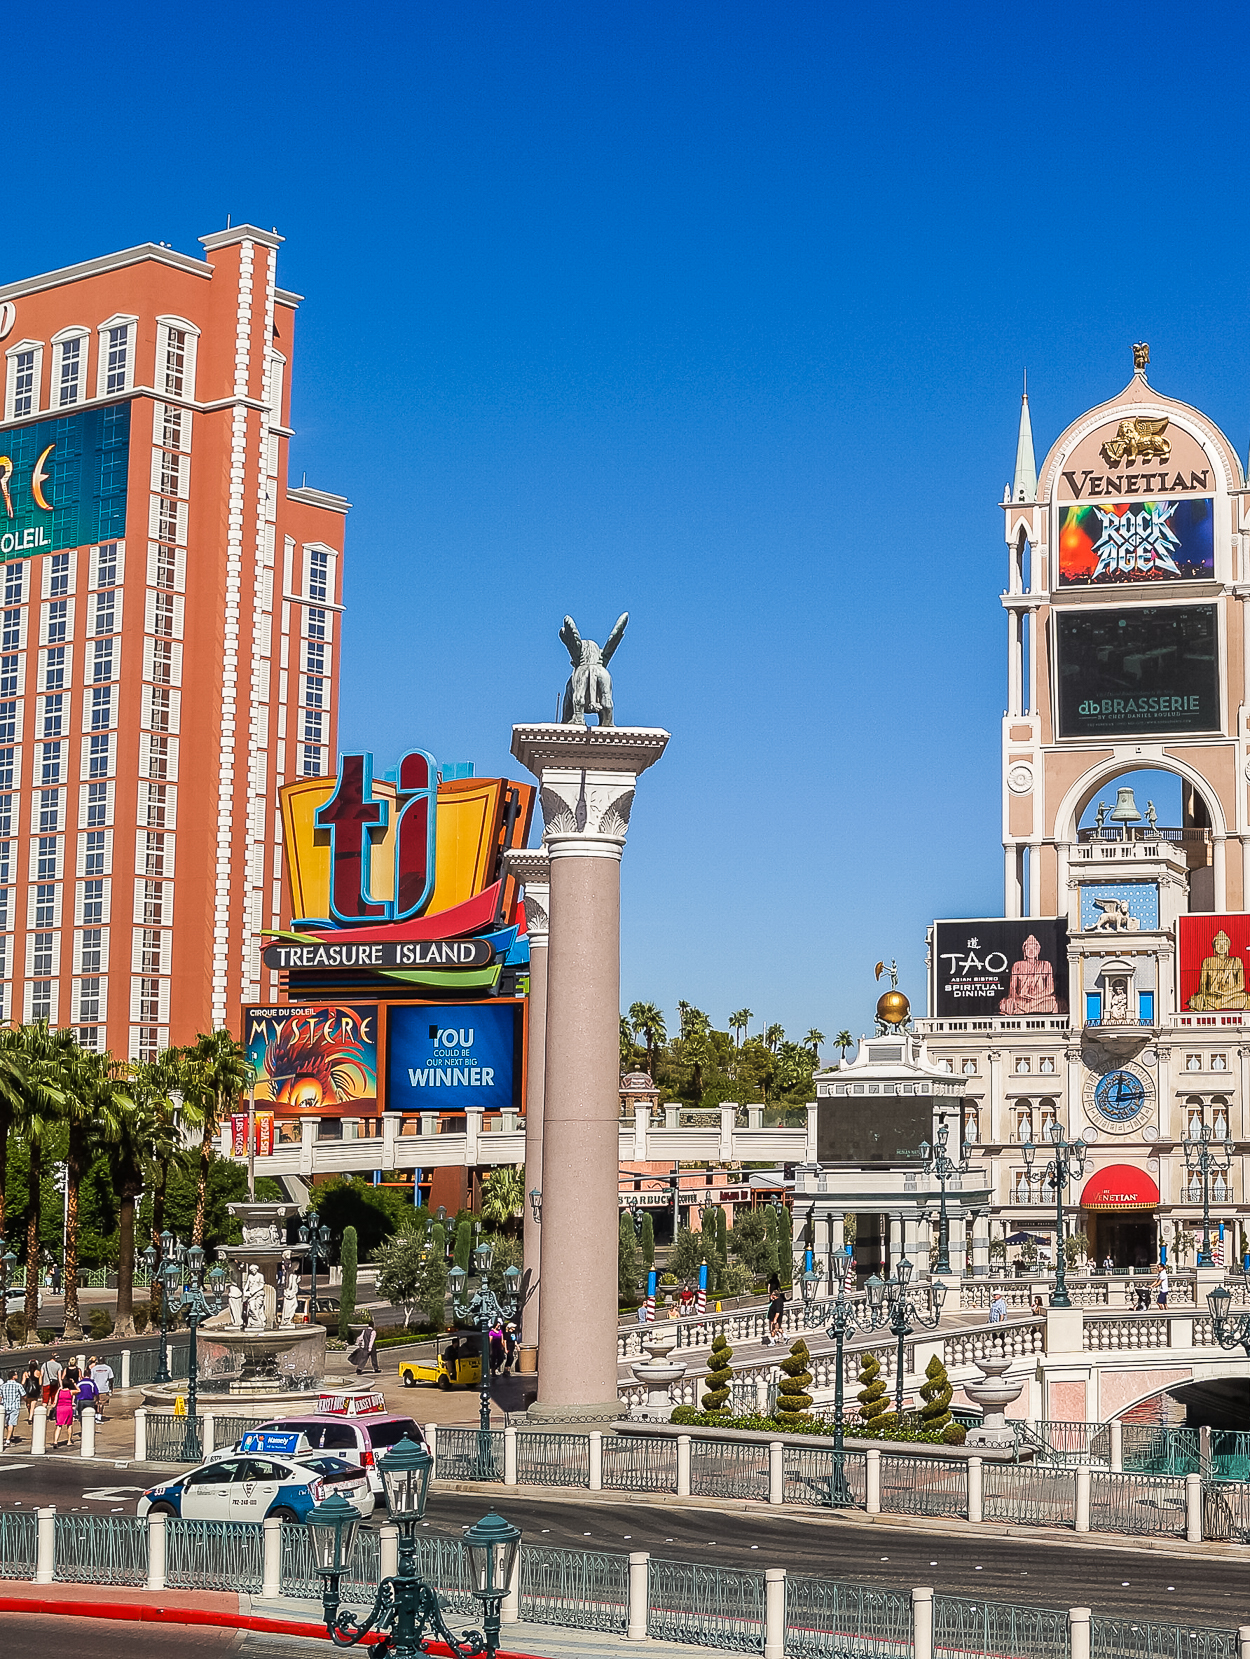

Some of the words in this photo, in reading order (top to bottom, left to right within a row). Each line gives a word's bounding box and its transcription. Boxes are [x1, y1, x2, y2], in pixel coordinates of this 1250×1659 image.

[1062, 469, 1209, 500] VENETIAN
[1091, 502, 1182, 550] ROCK
[1128, 534, 1142, 546] OF
[1091, 538, 1182, 579] AGES
[276, 944, 383, 967] TREASURE
[395, 942, 476, 965] ISLAND
[250, 1009, 278, 1018] CIRQUE
[291, 1008, 317, 1016] SOLEIL
[249, 1012, 373, 1048] MYSTÈRE
[426, 1058, 443, 1066] OUR
[444, 1058, 463, 1066] NEXT
[464, 1058, 478, 1066] BIG
[434, 1049, 460, 1057] COULD
[461, 1049, 470, 1057] BE
[408, 1067, 495, 1087] WINNER
[235, 1118, 244, 1131] LAS
[260, 1118, 270, 1139] VEGAS
[235, 1132, 244, 1155] VEGAS
[260, 1140, 270, 1155] LAS
[1093, 1193, 1137, 1201] VENETIAN
[355, 1397, 372, 1412] JERSEY
[371, 1394, 384, 1407] BOYS
